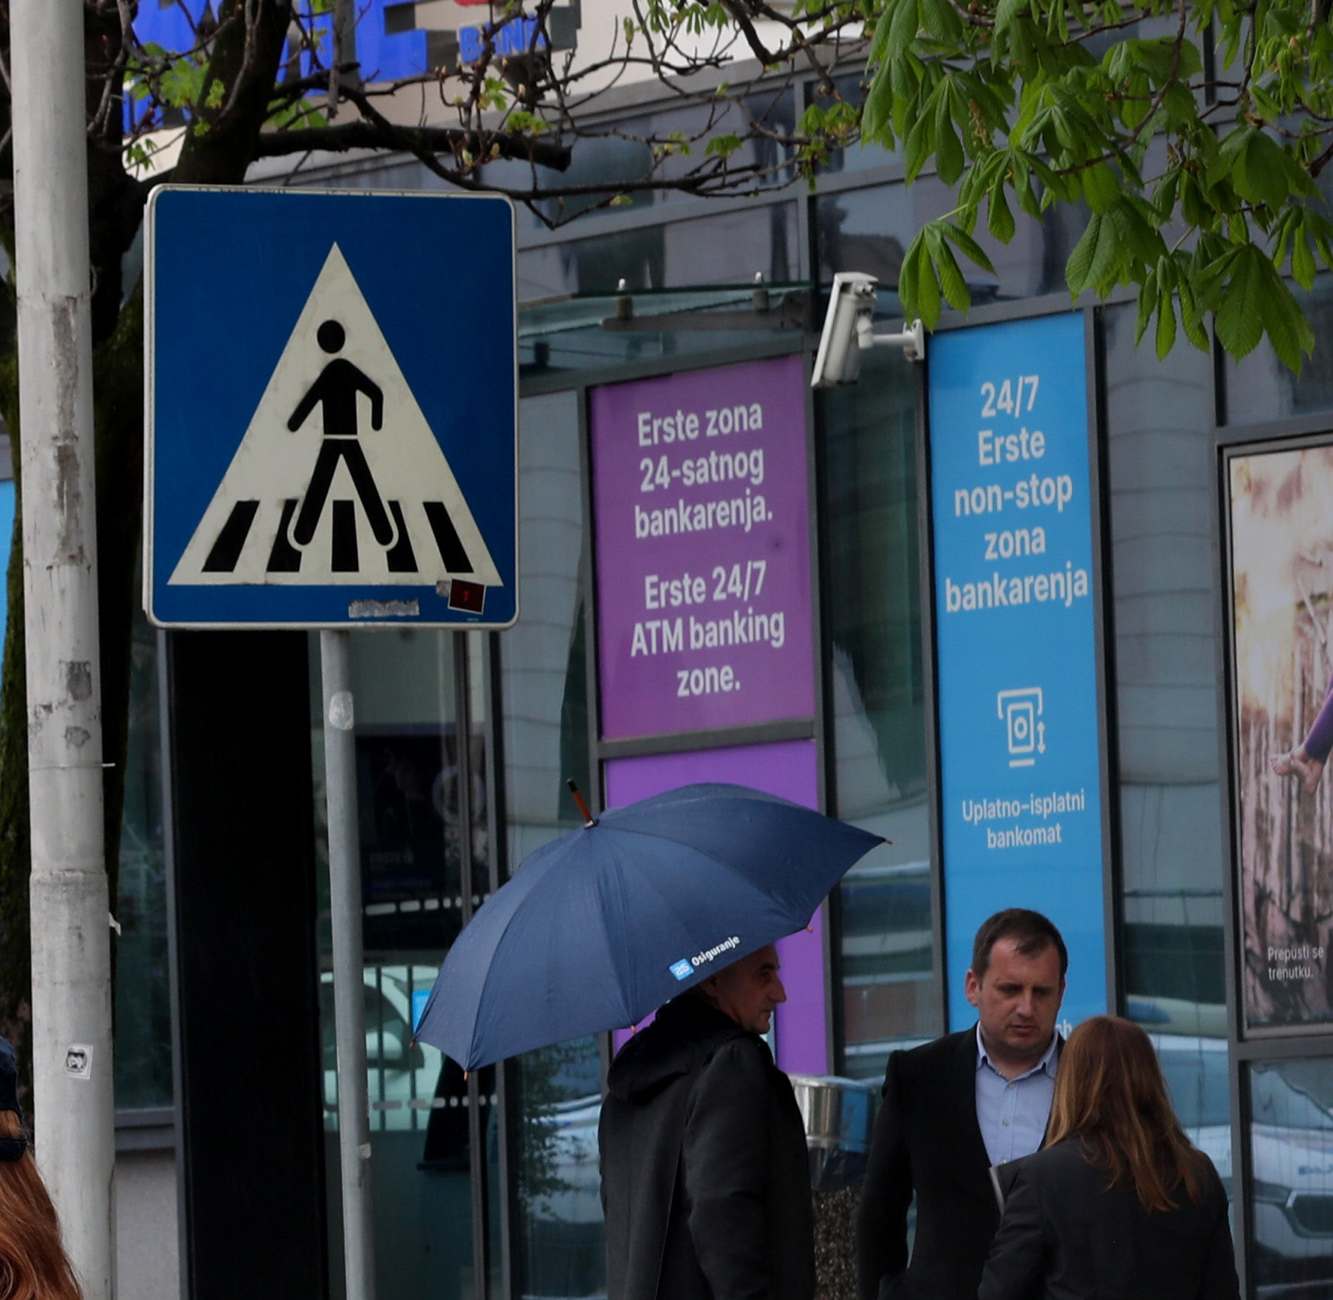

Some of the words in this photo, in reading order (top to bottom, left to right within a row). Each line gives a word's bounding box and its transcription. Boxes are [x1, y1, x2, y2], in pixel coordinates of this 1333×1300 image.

[980, 375, 1039, 418] 24/7
[637, 409, 699, 447] Erste
[705, 403, 763, 437] zona
[978, 426, 1046, 466] Erste
[639, 448, 765, 492] 24-satnog
[634, 487, 773, 538] bankarenja.
[954, 473, 1073, 517] non-stop
[984, 525, 1046, 560] zona
[644, 571, 706, 610] Erste
[712, 560, 766, 602] 24/7
[945, 561, 1088, 613] bankarenja
[631, 617, 684, 657] ATM
[689, 606, 785, 651] banking
[676, 664, 741, 698] zone.
[987, 822, 1062, 849] bankomat
[691, 936, 740, 966] Osiguranje
[1268, 945, 1309, 963] Prepusti
[1312, 946, 1324, 959] se
[1268, 965, 1314, 981] trenutku.
